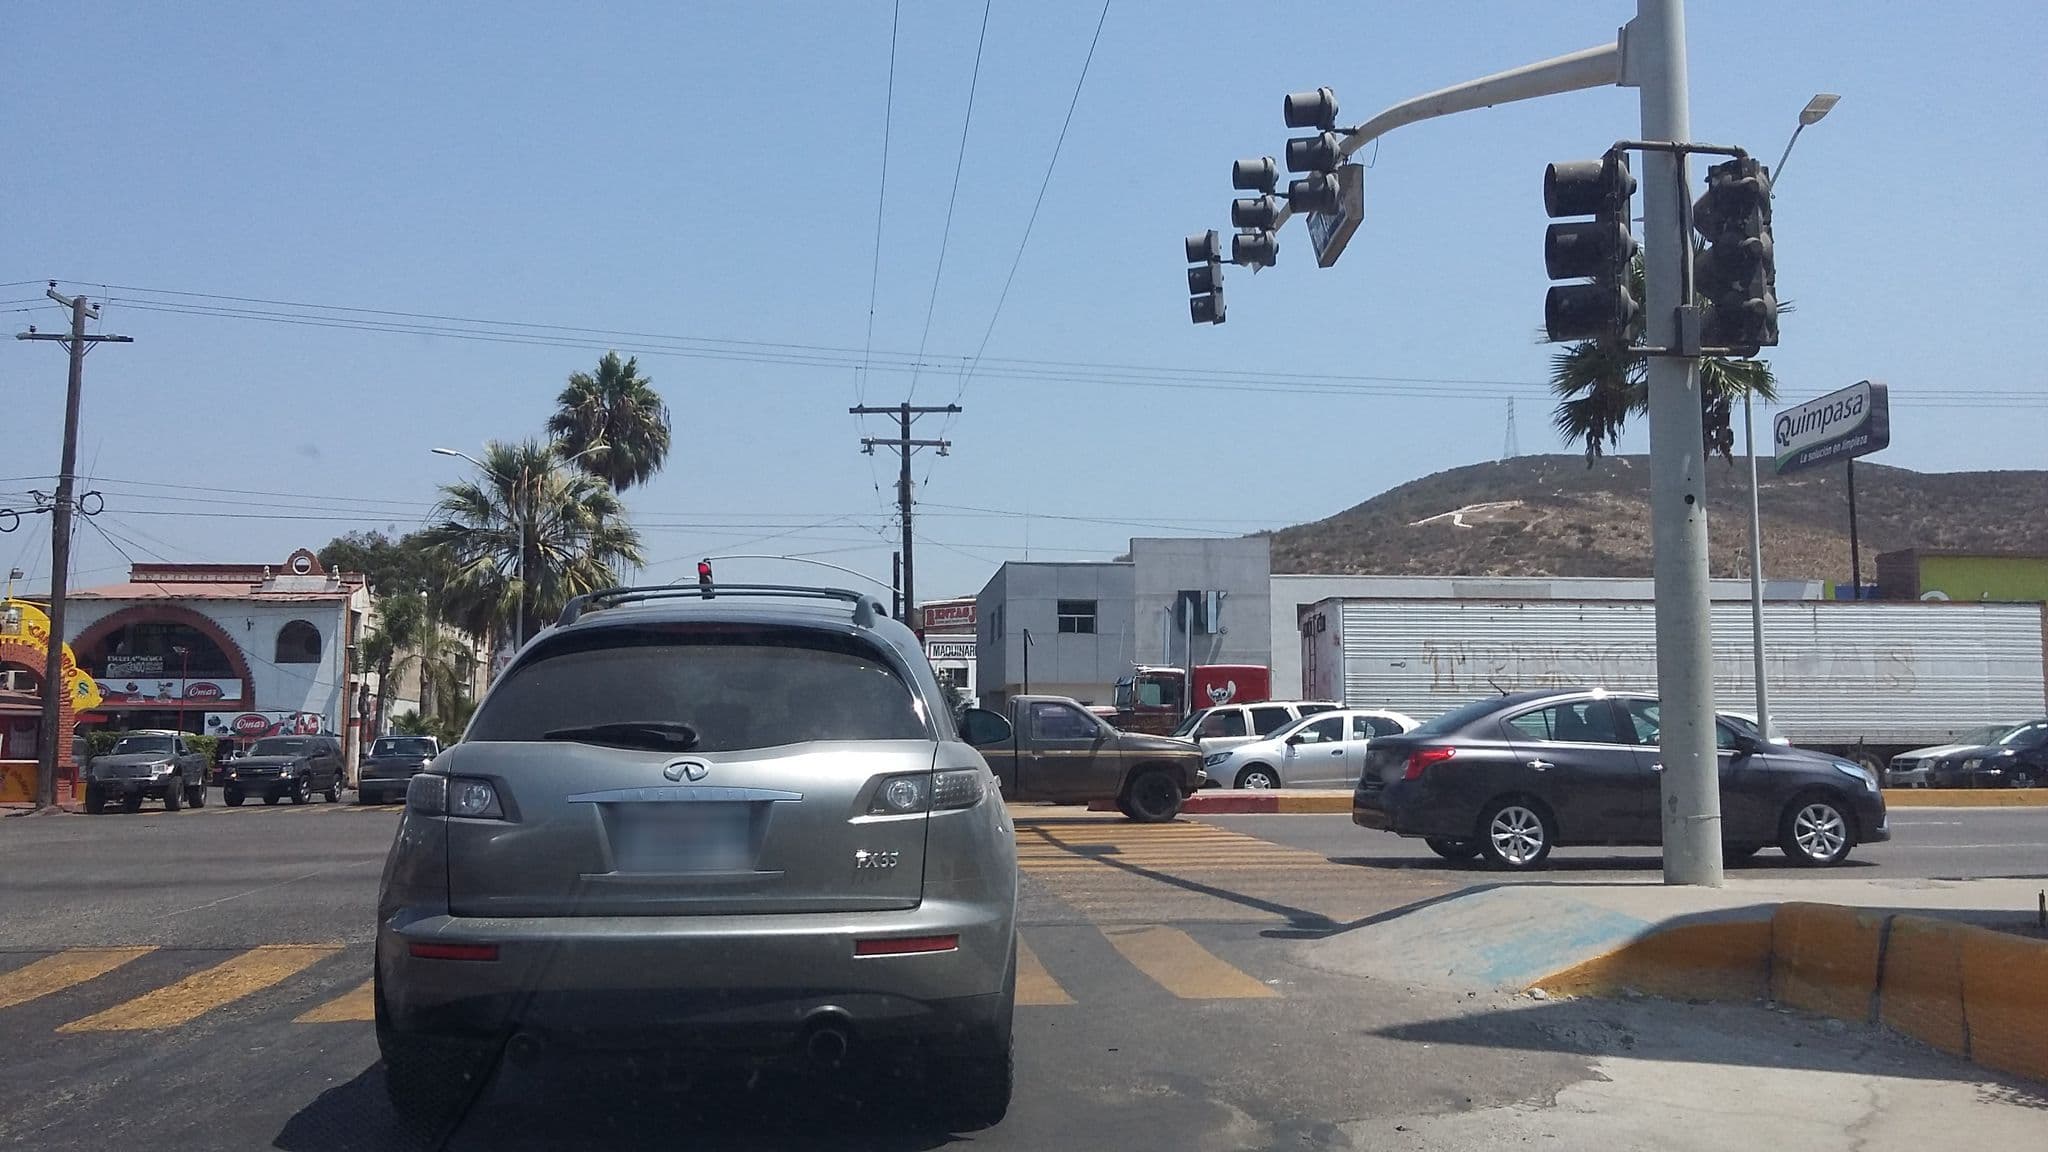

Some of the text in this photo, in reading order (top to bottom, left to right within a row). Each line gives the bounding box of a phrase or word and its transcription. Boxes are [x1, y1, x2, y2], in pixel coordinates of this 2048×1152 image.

[1776, 394, 1862, 446] Quimpasa
[189, 686, 217, 697] Omar
[236, 719, 265, 730] Omar
